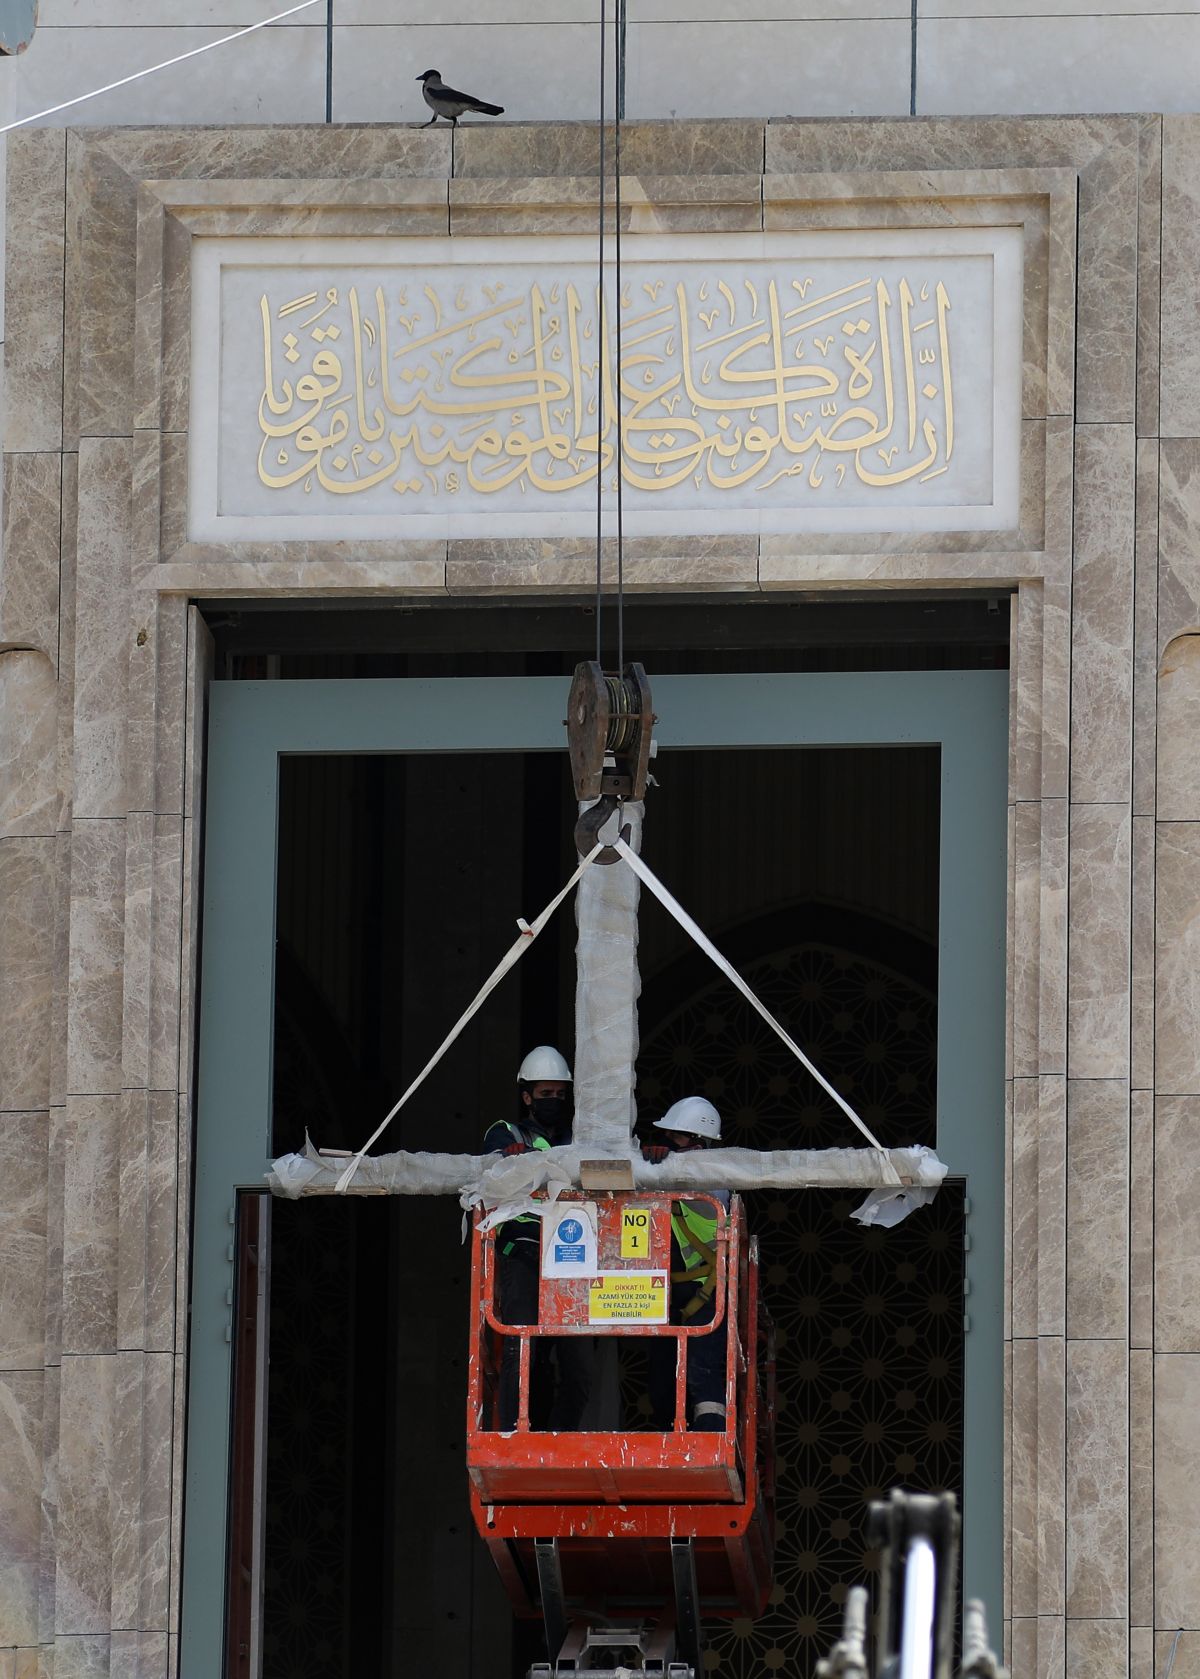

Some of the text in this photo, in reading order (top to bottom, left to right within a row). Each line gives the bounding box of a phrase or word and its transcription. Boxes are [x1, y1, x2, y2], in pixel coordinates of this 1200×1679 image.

[624, 1214, 647, 1227] NO
[631, 1235, 639, 1248] 1
[614, 1283, 638, 1291] DİKKAT
[597, 1292, 619, 1300] AZAMİ
[620, 1292, 634, 1300] YÜK
[648, 1293, 657, 1301] kg
[639, 1302, 651, 1310] kişi
[611, 1310, 642, 1318] BİNEBİLİR
